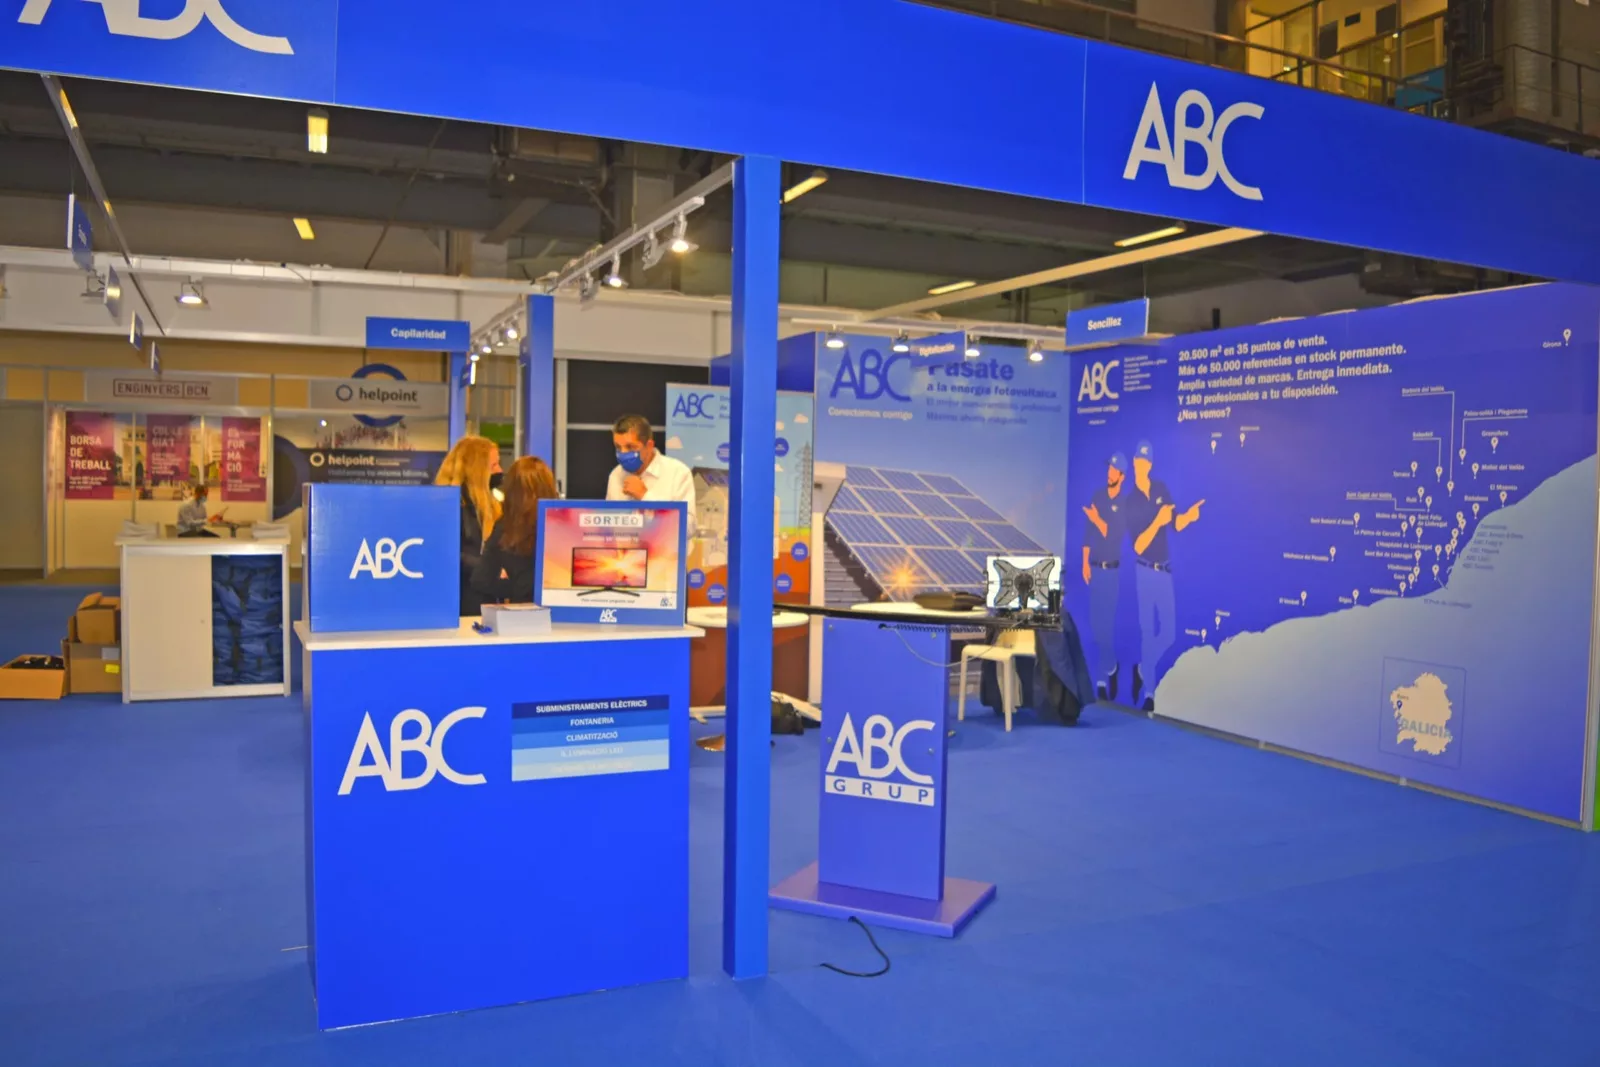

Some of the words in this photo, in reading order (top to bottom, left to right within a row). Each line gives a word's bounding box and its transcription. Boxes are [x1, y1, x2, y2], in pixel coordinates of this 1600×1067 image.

[1123, 80, 1265, 200] ABC
[1088, 317, 1122, 330] Sencillez
[391, 328, 446, 340] Capilaridad
[1179, 348, 1208, 362] 20.500
[1224, 347, 1234, 356] en
[1237, 343, 1248, 354] 35
[1251, 340, 1280, 355] puntos
[1284, 339, 1295, 349] de
[1298, 335, 1327, 347] venta.
[1179, 365, 1195, 376] Más
[1198, 364, 1207, 374] de
[1210, 360, 1240, 373] 50.000
[1243, 356, 1292, 369] referencias
[1295, 354, 1306, 364] en
[1309, 349, 1336, 363] stock
[1340, 343, 1406, 362] permanente.
[830, 348, 912, 402] ABC
[1078, 360, 1119, 401] ABC
[1178, 380, 1205, 392] Amplia
[1208, 376, 1242, 388] variedad
[1245, 374, 1255, 385] de
[1258, 373, 1293, 384] marcas.
[1297, 368, 1334, 380] Entrega
[1337, 363, 1392, 377] inmediata.
[117, 384, 180, 396] ENGINYERS
[187, 386, 208, 396] BCN
[359, 388, 418, 403] helpoint
[927, 383, 934, 392] a
[937, 382, 947, 392] la
[994, 382, 1057, 398] fotovoltaica
[1178, 395, 1183, 405] Y
[1186, 394, 1201, 404] 180
[1204, 390, 1259, 405] profesionales
[1262, 391, 1267, 399] a
[1270, 389, 1280, 398] tu
[1282, 384, 1338, 399] disposición.
[672, 393, 714, 419] ABC
[828, 406, 880, 418] Conectamos
[883, 410, 913, 420] contigo
[1178, 410, 1197, 422] ¿Nos
[1200, 407, 1231, 419] vemos?
[70, 436, 102, 446] BORSA
[70, 448, 83, 456] DE
[227, 451, 241, 460] MA
[70, 460, 111, 470] TREBALL
[328, 454, 375, 467] helpoint
[584, 516, 639, 525] SORTEO
[349, 538, 424, 579] ABC
[536, 702, 608, 713] SUBMINISTRAMENTS
[611, 700, 647, 709] ELÈCTRICS
[570, 717, 614, 726] FONTANERIA
[1400, 719, 1452, 739] GALICIA
[566, 732, 618, 742] CLIMATITZACIÓ
[338, 706, 487, 795] ABC
[826, 712, 935, 784] ABC
[834, 779, 928, 802] GRUP
